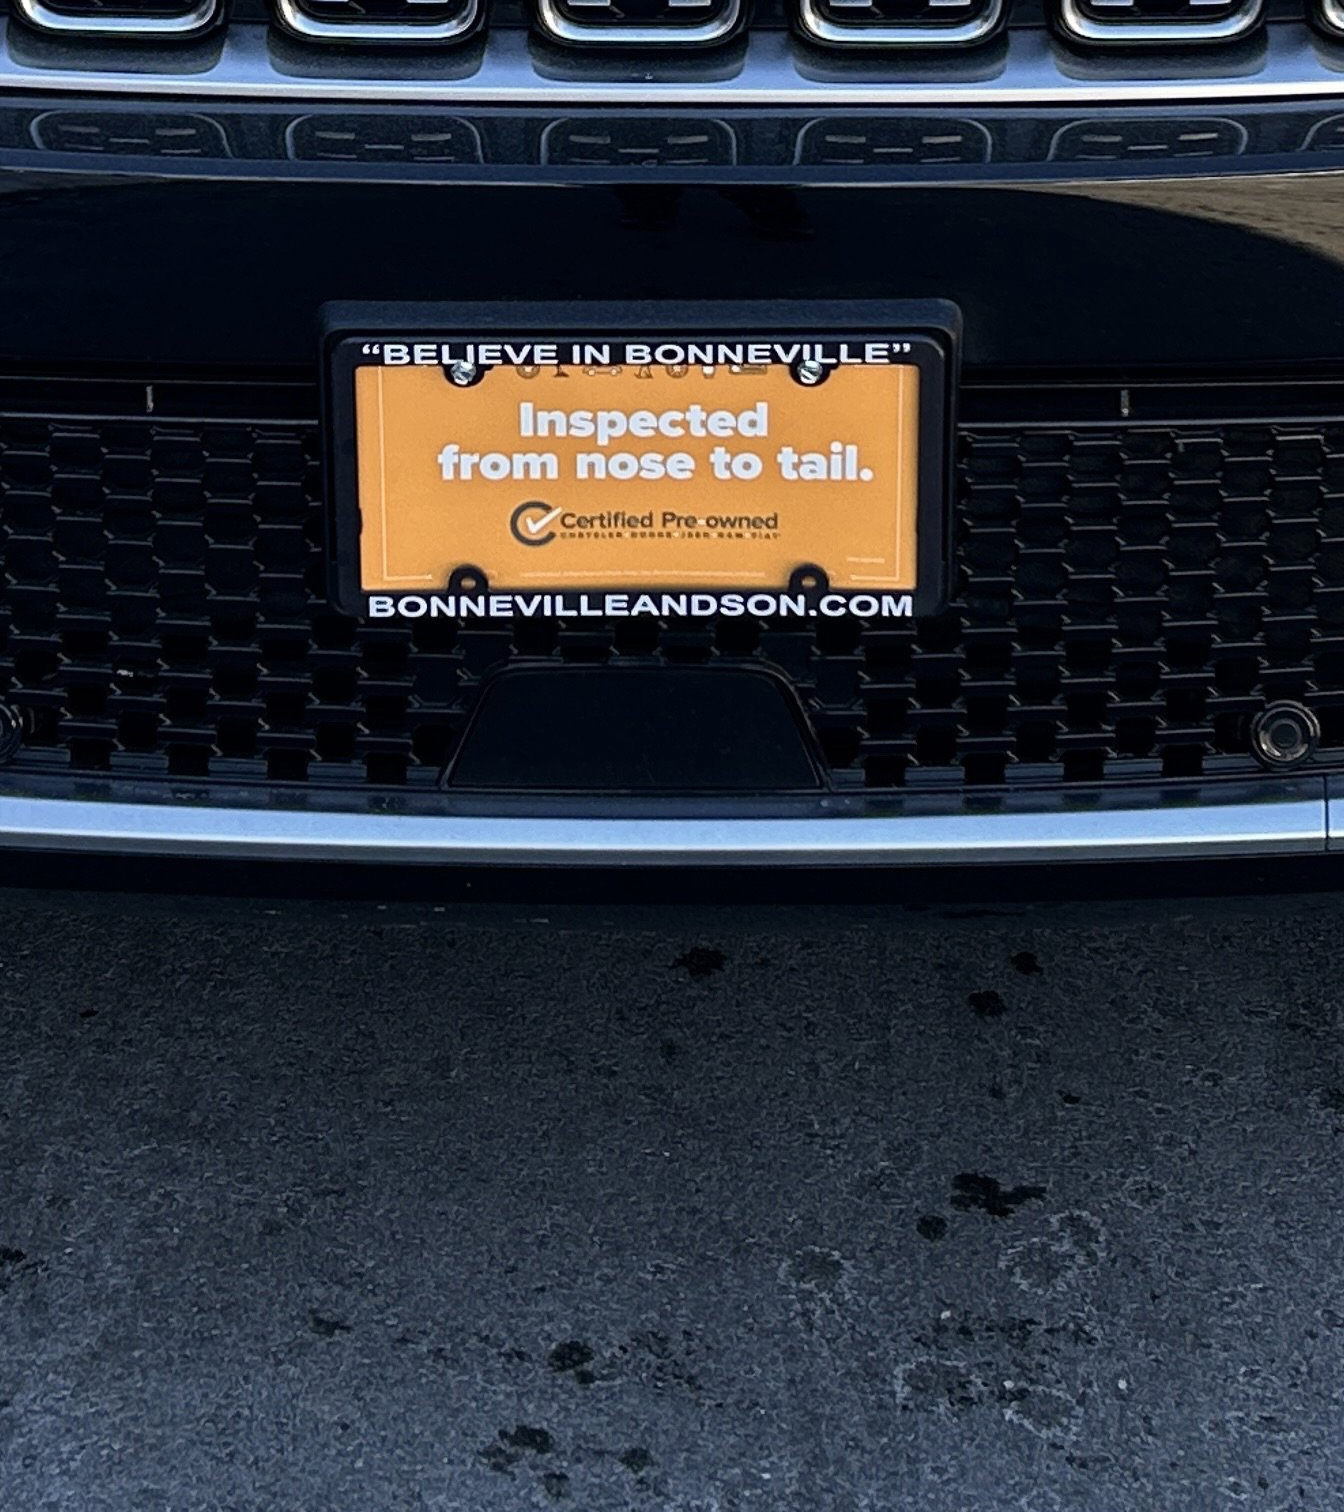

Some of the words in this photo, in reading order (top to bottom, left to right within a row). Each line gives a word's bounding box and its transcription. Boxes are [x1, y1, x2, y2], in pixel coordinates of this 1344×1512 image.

[572, 344, 610, 364] IN
[519, 401, 768, 445] Inspected
[437, 444, 559, 481] from
[576, 451, 695, 480] nose
[710, 446, 763, 480] to
[776, 441, 874, 482] tail.
[560, 510, 654, 529] Certified
[369, 594, 913, 618] BONNEVILLEANDSON.COM
